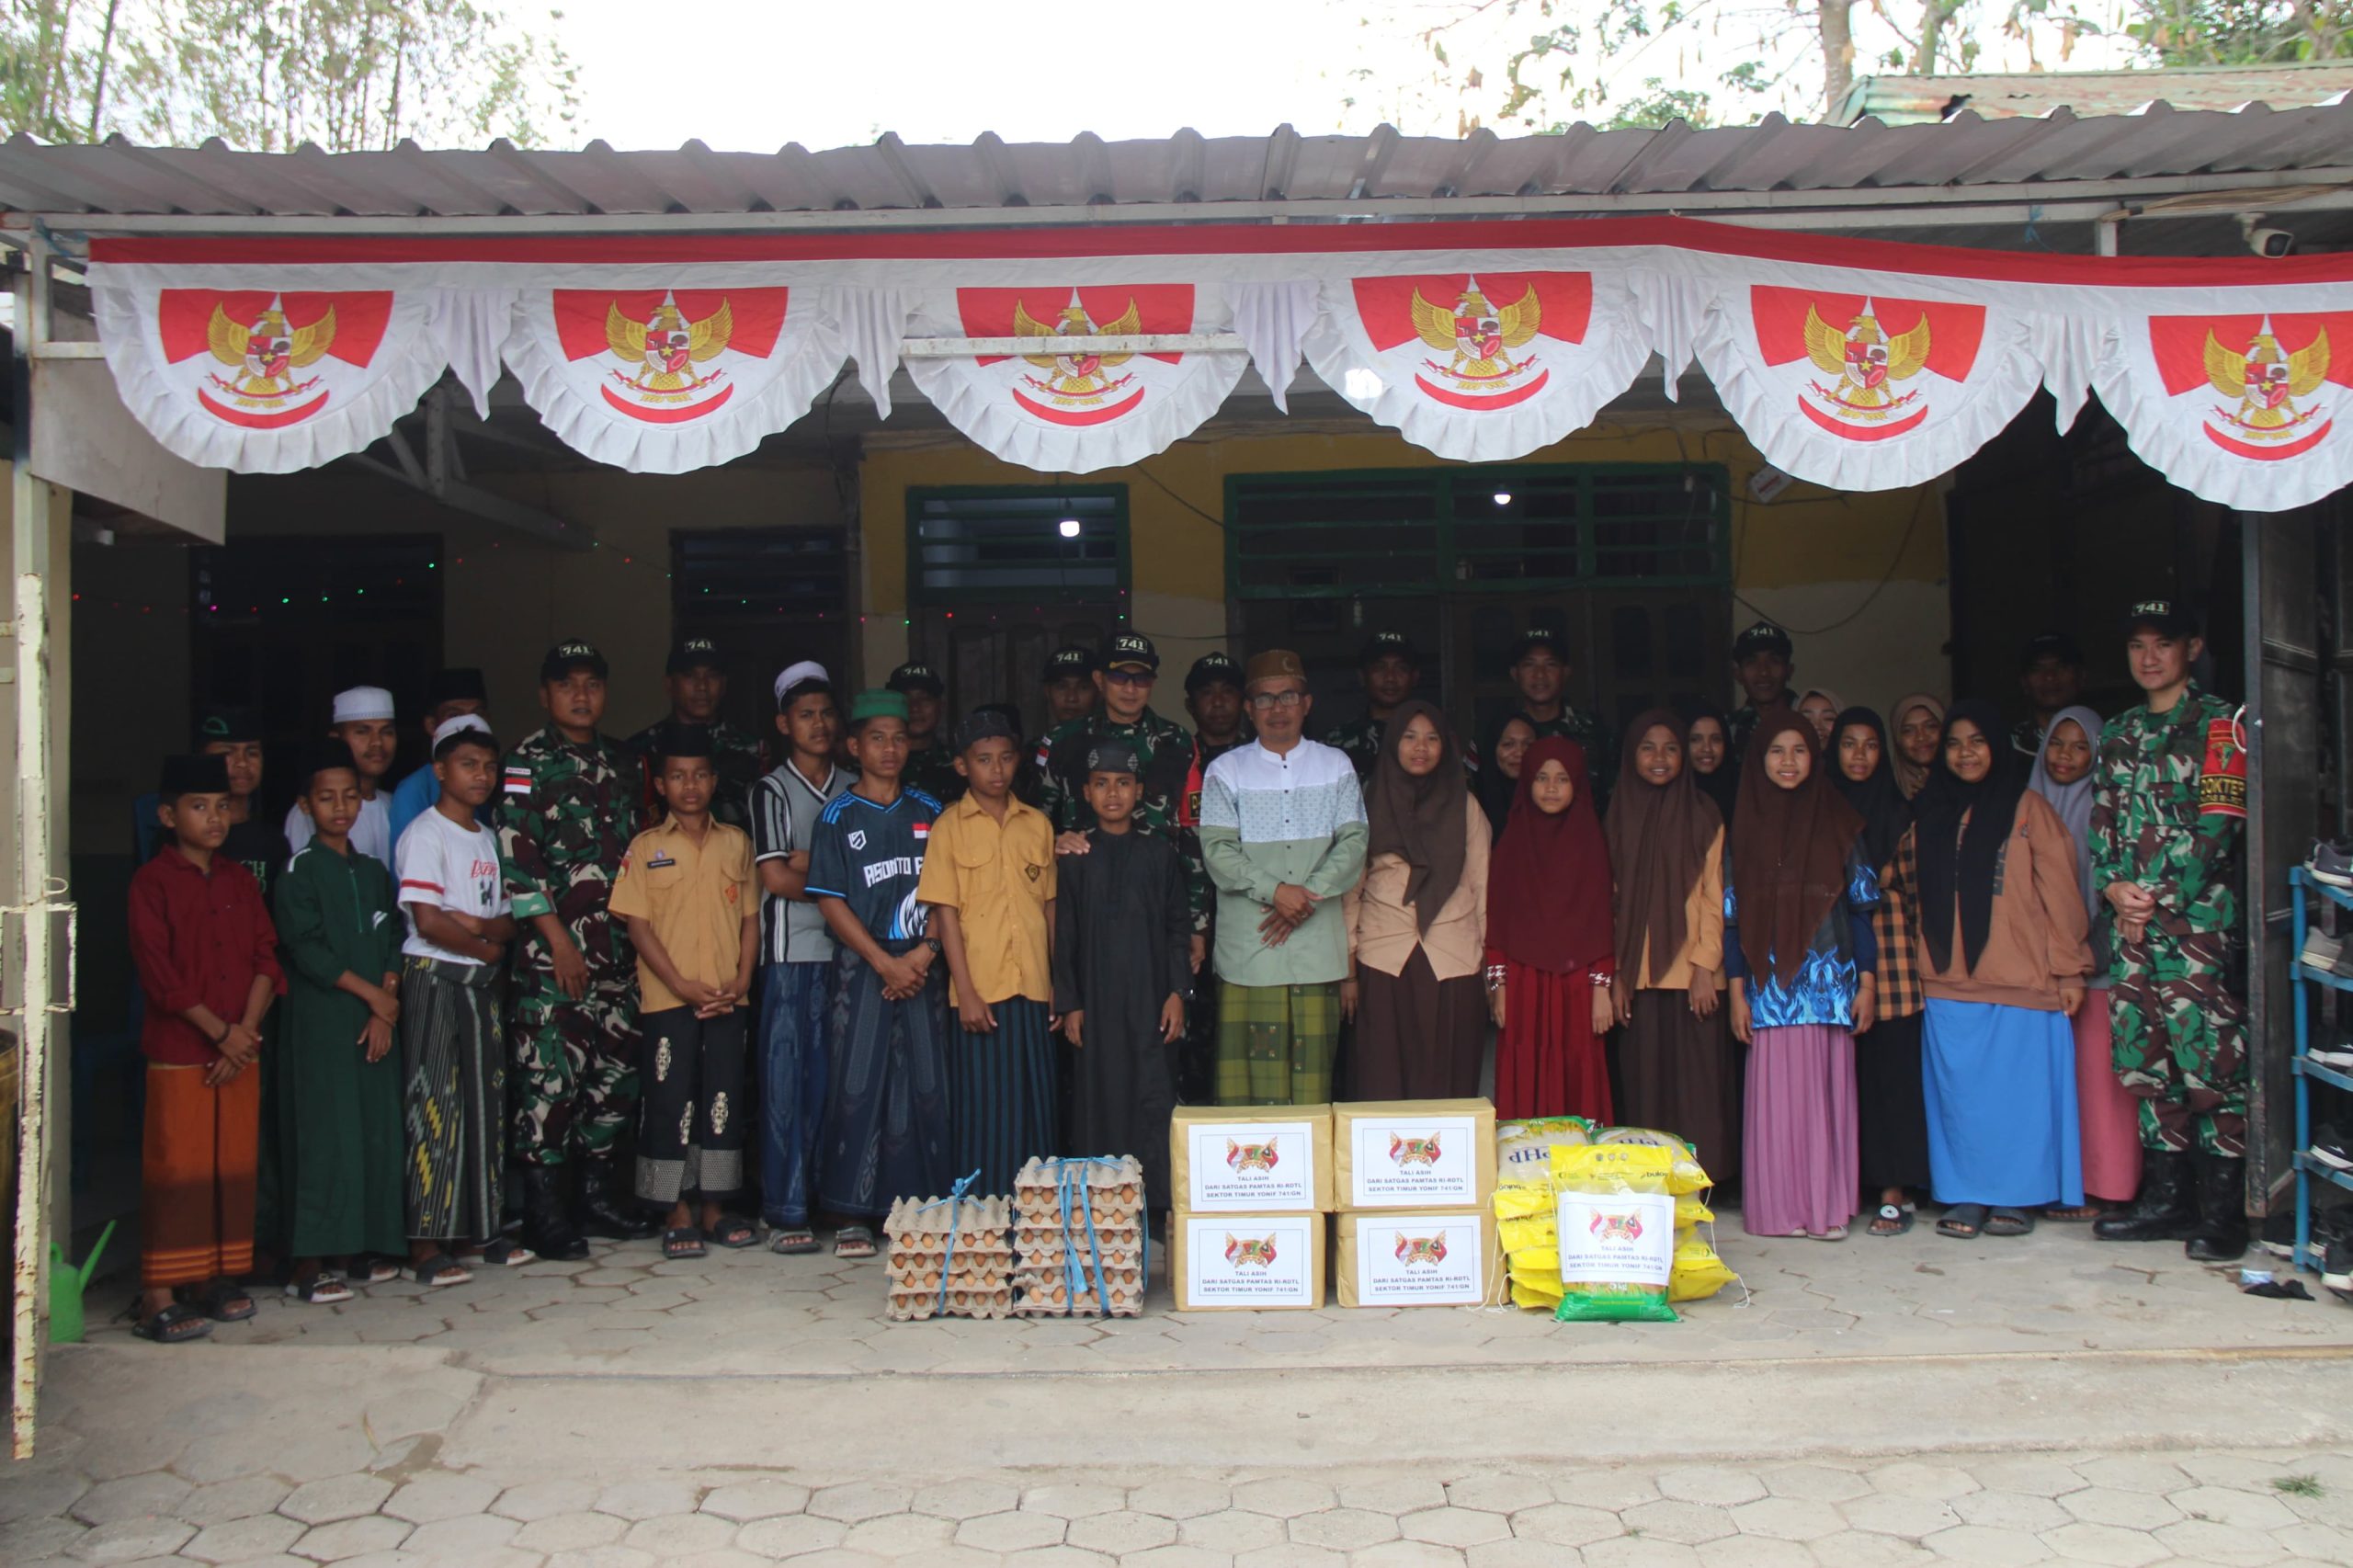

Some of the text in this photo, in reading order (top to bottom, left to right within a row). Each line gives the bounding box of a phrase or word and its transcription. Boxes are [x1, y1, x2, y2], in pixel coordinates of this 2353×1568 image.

[2136, 603, 2165, 613] 741
[1528, 630, 1549, 638] 741
[1751, 627, 1773, 636] 741
[1380, 633, 1401, 642] 741
[563, 644, 590, 655] 741
[688, 641, 712, 650] 741
[1120, 638, 1144, 652] 741
[1057, 653, 1079, 663] 741
[1206, 656, 1229, 666] 741
[904, 667, 927, 676] 741
